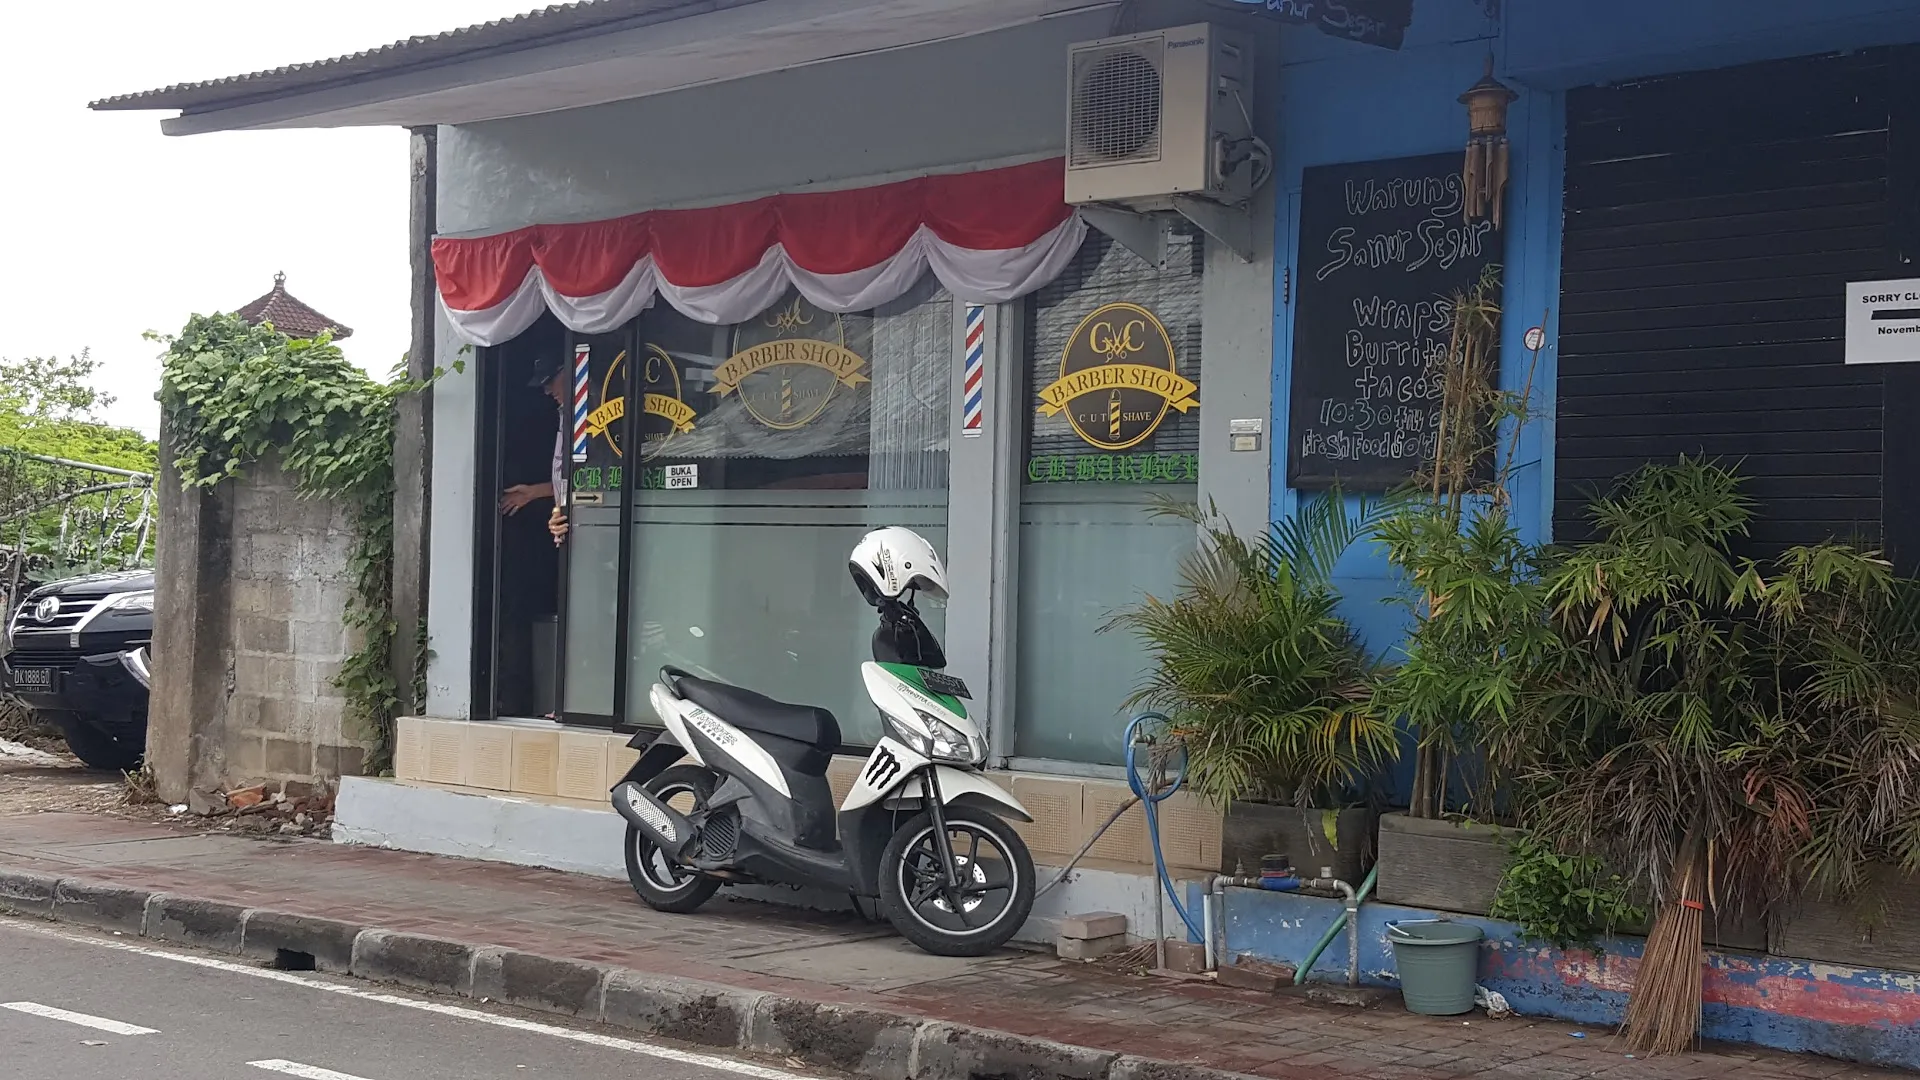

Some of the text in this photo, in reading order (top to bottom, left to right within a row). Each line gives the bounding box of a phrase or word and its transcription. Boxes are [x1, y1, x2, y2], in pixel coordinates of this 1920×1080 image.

[1266, 0, 1314, 20] anur
[1167, 37, 1204, 48] Panasonic
[1345, 173, 1465, 218] Warung
[1316, 227, 1412, 281] Sanur
[1862, 293, 1901, 304] SORRY
[725, 342, 852, 382] BARBER SHOP
[1051, 367, 1184, 403] BARBER SHOP
[650, 397, 687, 420] SHOP
[1079, 411, 1151, 423] CUT SHAVE
[670, 466, 692, 476] BUKA
[670, 477, 692, 487] OPEN
[14, 669, 25, 684] DK
